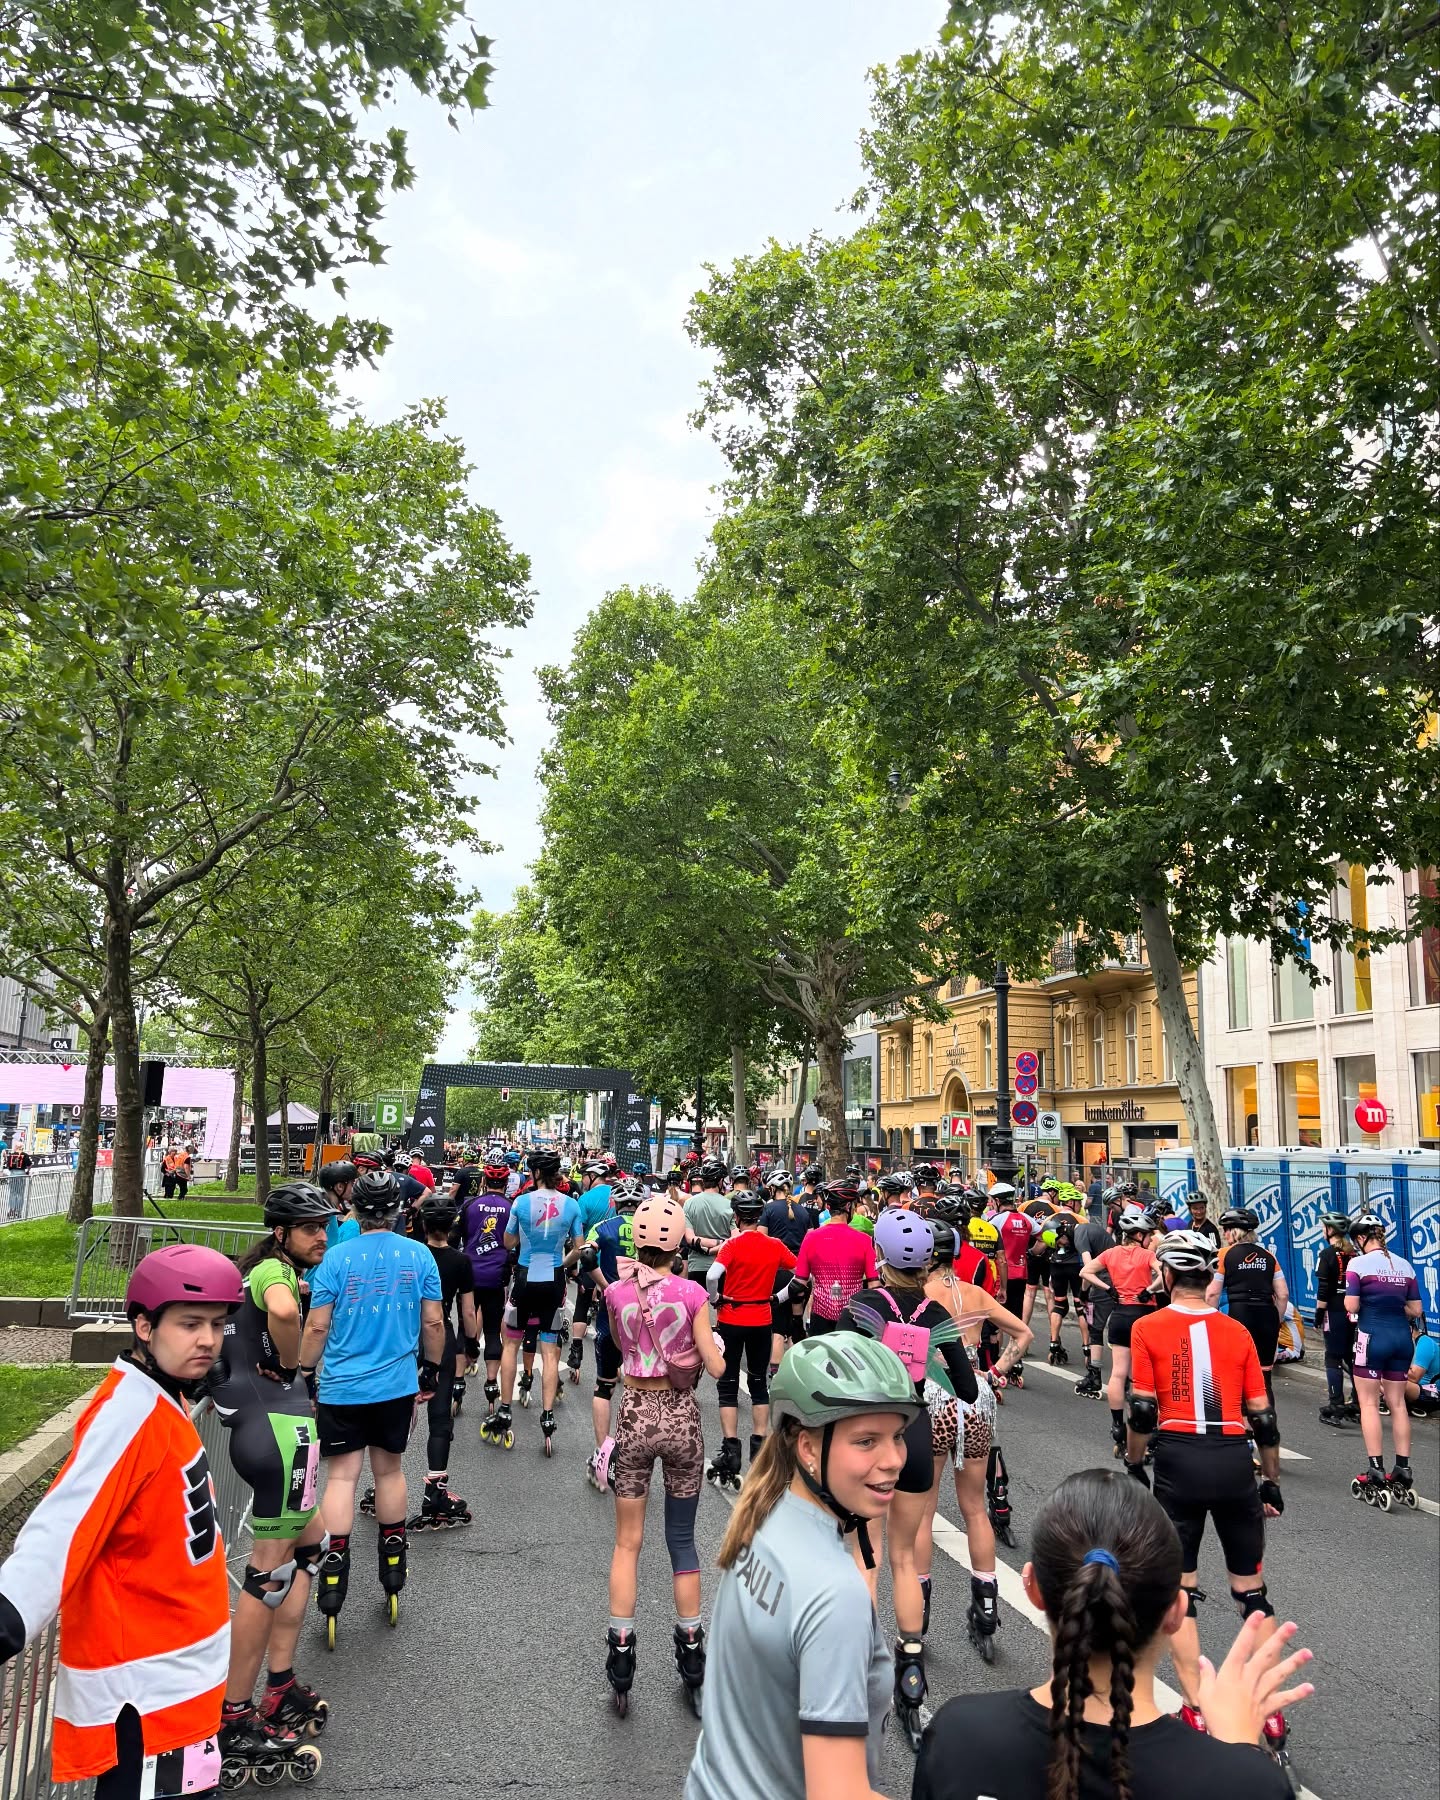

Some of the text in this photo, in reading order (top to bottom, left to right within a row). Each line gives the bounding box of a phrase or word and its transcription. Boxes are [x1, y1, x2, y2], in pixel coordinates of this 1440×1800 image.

[382, 1104, 398, 1125] B
[1085, 1099, 1145, 1120] hunkemöller
[1366, 1107, 1384, 1123] m
[954, 1119, 968, 1136] A
[478, 1203, 506, 1213] Team
[475, 1240, 499, 1256] B&B
[345, 1250, 417, 1265] START
[1238, 1262, 1267, 1271] skating
[1377, 1275, 1407, 1284] TO SKATE
[348, 1301, 415, 1316] FINISH
[1172, 1353, 1181, 1402] BERNAUER
[1181, 1337, 1191, 1403] LAUFFREUNDE
[596, 1452, 605, 1472] 726
[731, 1543, 784, 1616] PAULI
